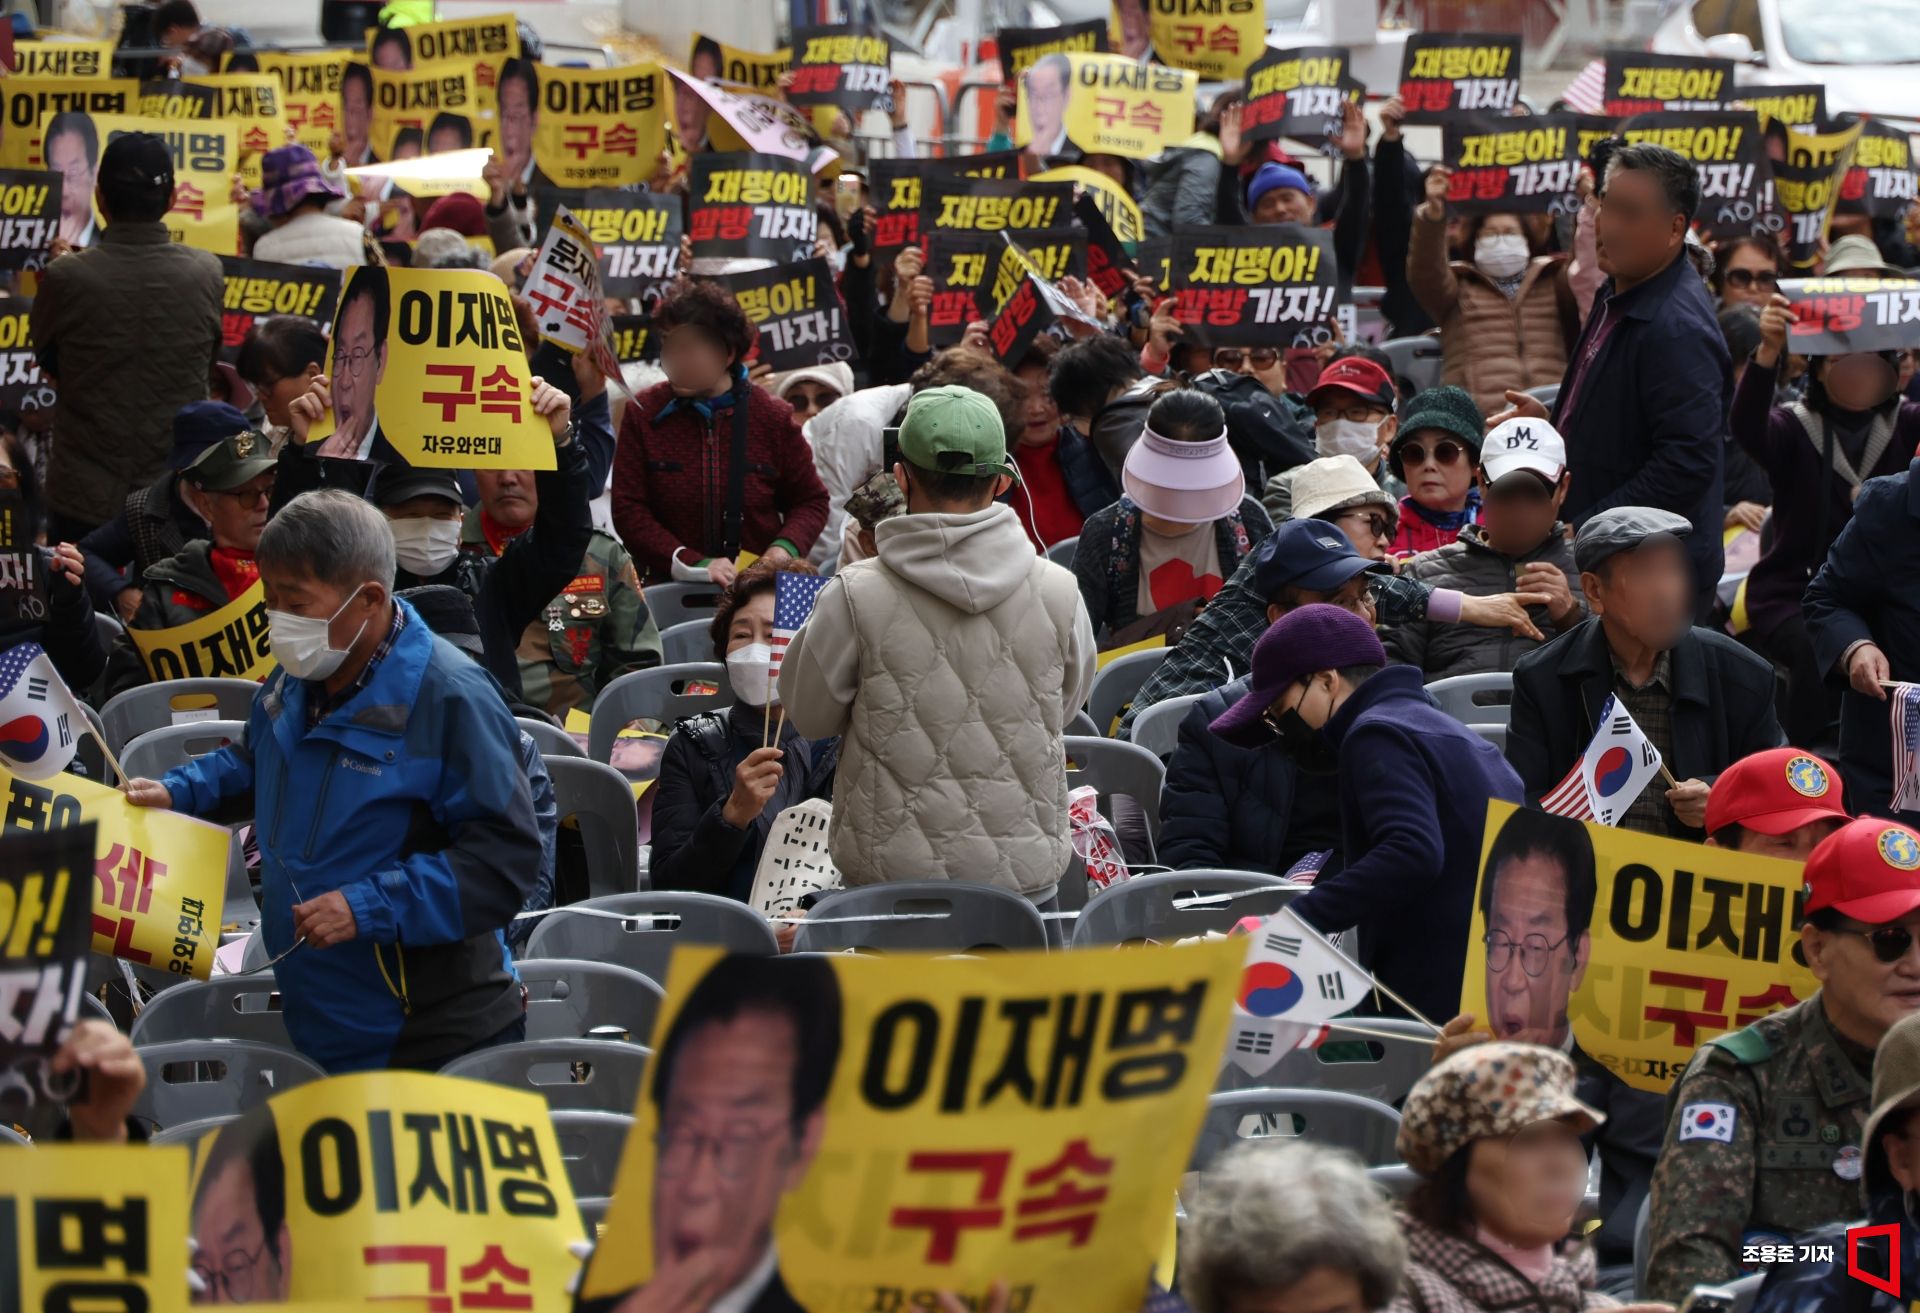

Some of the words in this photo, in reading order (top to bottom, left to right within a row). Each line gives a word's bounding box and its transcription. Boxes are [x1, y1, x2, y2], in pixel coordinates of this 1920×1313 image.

[417, 23, 508, 59] 이재명
[802, 37, 886, 64] 재명아!
[1174, 24, 1239, 56] 구속
[1410, 47, 1511, 79] 재명아!
[379, 73, 466, 110] 이재명
[546, 75, 656, 115] 이재명
[1453, 78, 1519, 110] 가자!
[1618, 67, 1724, 99] 재명아!
[1094, 97, 1163, 135] 구속
[564, 122, 638, 160] 구속
[1459, 128, 1567, 167] 재명아!
[704, 170, 808, 206] 재명아!
[1509, 160, 1581, 196] 가자!
[753, 205, 818, 243] 가자!
[935, 195, 1061, 231] 재명아!
[1189, 246, 1320, 285] 재명아!
[398, 289, 524, 353] 이재명
[1247, 285, 1335, 325] 가자!
[760, 307, 841, 352] 가자!
[423, 364, 523, 424] 구속
[421, 435, 502, 456] 자유와연대
[860, 980, 1211, 1114] 이재명
[300, 1109, 559, 1219] 이재명
[890, 1138, 1116, 1266] 구속
